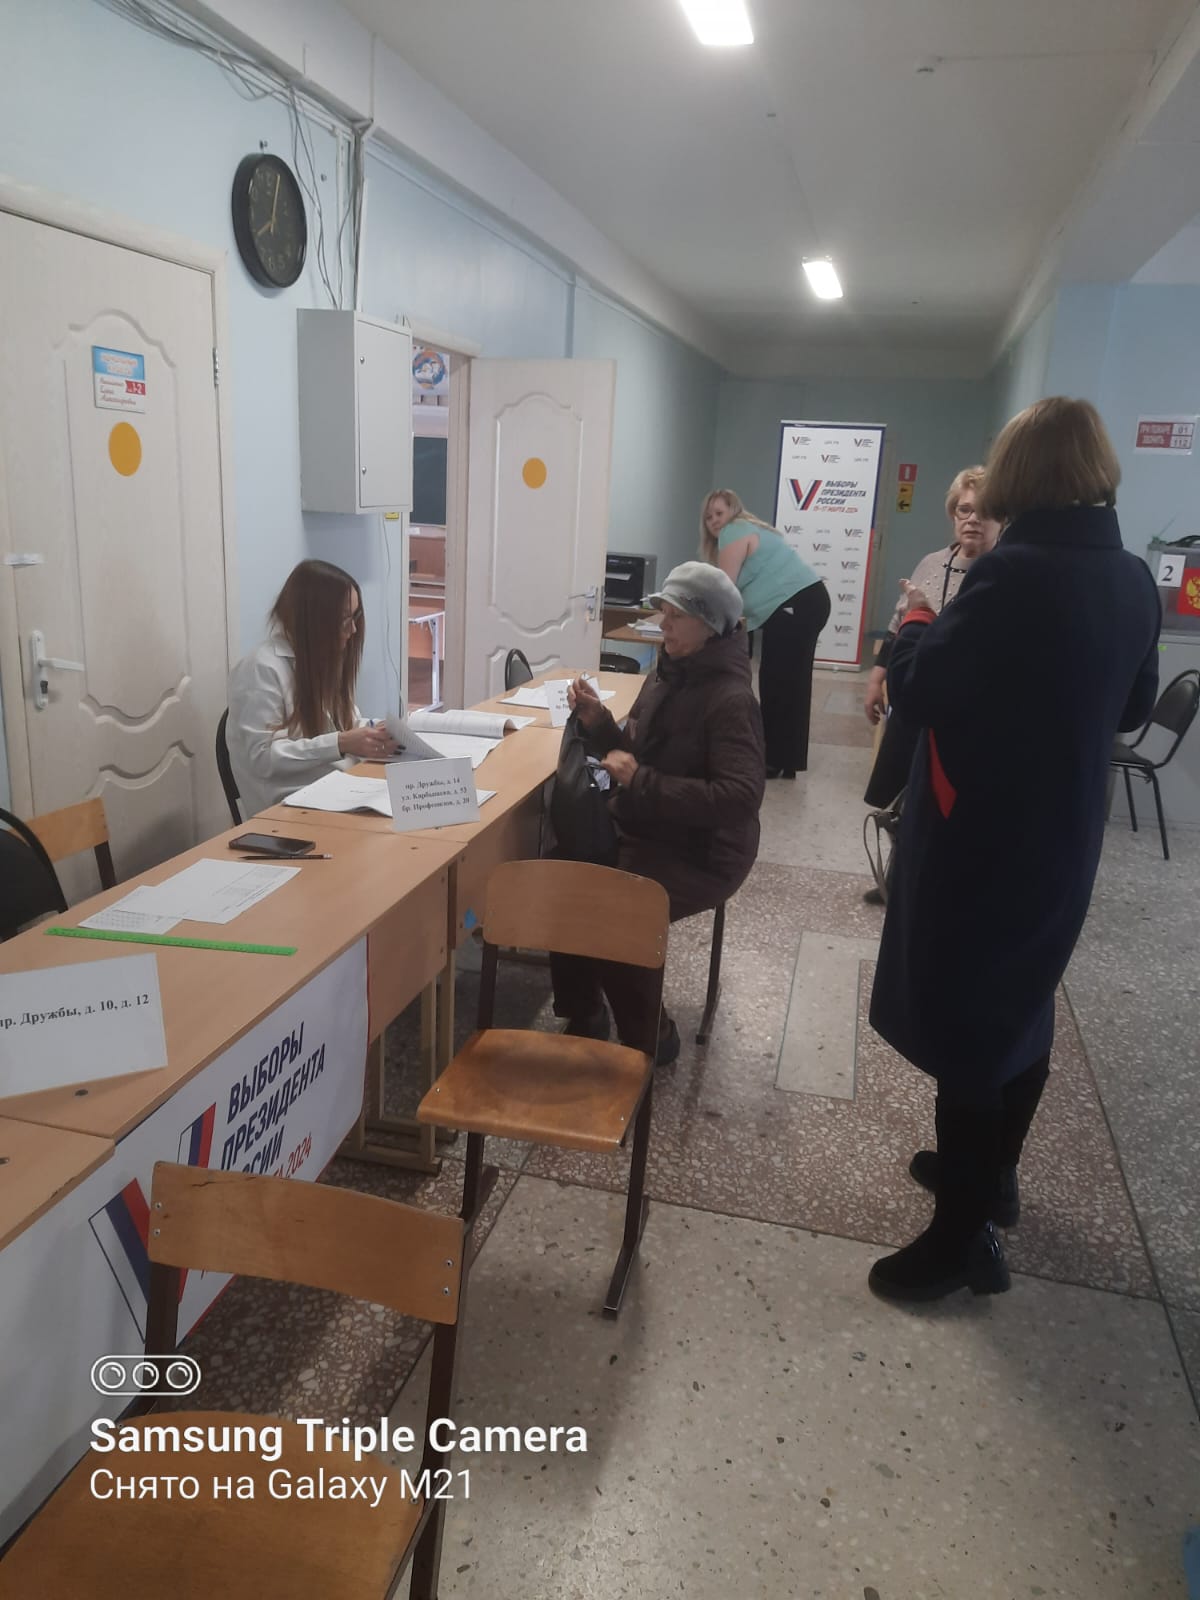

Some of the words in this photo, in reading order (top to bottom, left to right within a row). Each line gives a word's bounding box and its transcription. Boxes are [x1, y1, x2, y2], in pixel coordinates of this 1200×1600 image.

[821, 489, 866, 497] ПРЕЗИДЕНТА
[825, 480, 858, 488] ВЫБОРЫ
[1162, 565, 1174, 582] 2
[20, 1007, 82, 1026] Дружбы,
[85, 1005, 96, 1015] д.
[100, 1000, 118, 1011] 10,
[121, 999, 132, 1009] д.
[136, 994, 149, 1006] 12
[227, 1020, 304, 1124] ВЫБОРЫ
[221, 1043, 325, 1172] ПРЕЗИДЕНТА
